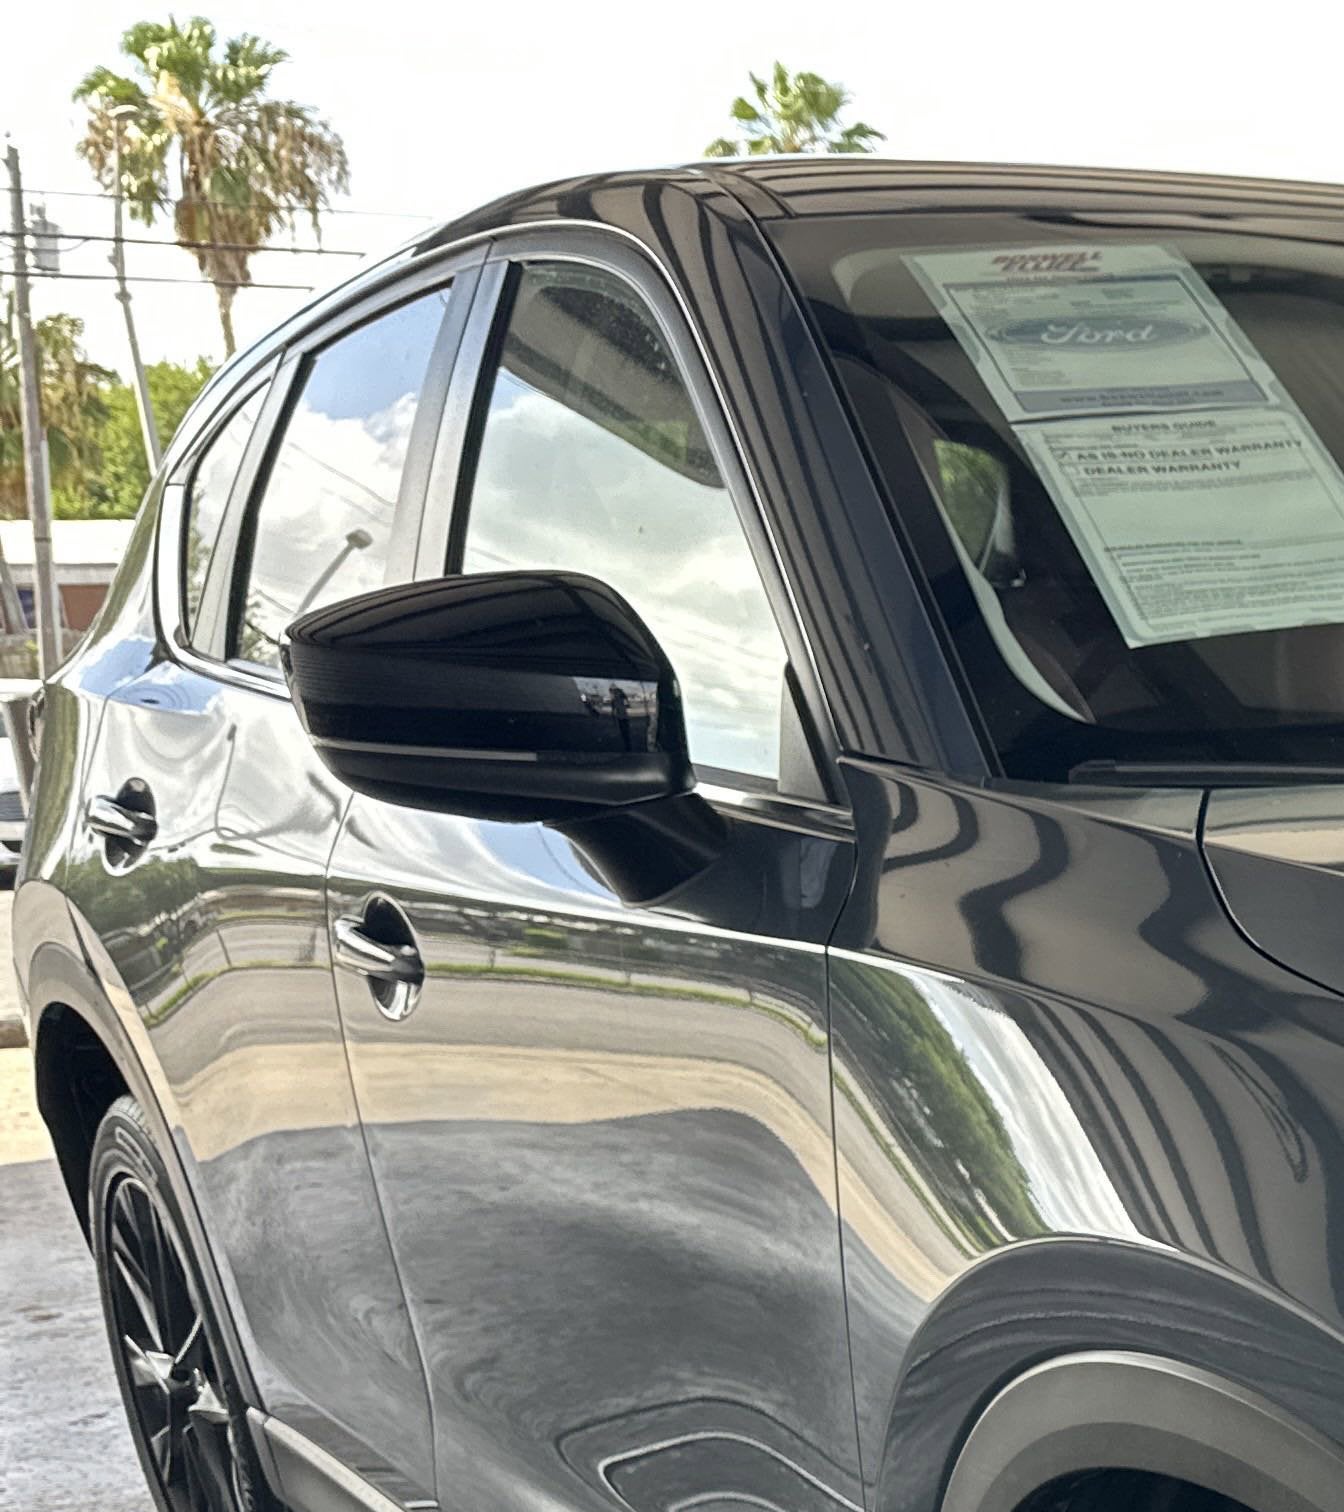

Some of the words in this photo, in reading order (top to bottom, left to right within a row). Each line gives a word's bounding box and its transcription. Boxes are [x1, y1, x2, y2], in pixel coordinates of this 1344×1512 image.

[1040, 323, 1154, 344] Ford
[1111, 423, 1170, 433] BUYERS
[1173, 420, 1217, 430] GUIDE
[1077, 452, 1098, 460] AS
[1149, 447, 1212, 459] DEALER
[1216, 440, 1302, 454] WARRANTY
[1083, 465, 1149, 476] DEALER
[1151, 461, 1241, 473] WARRANTY
